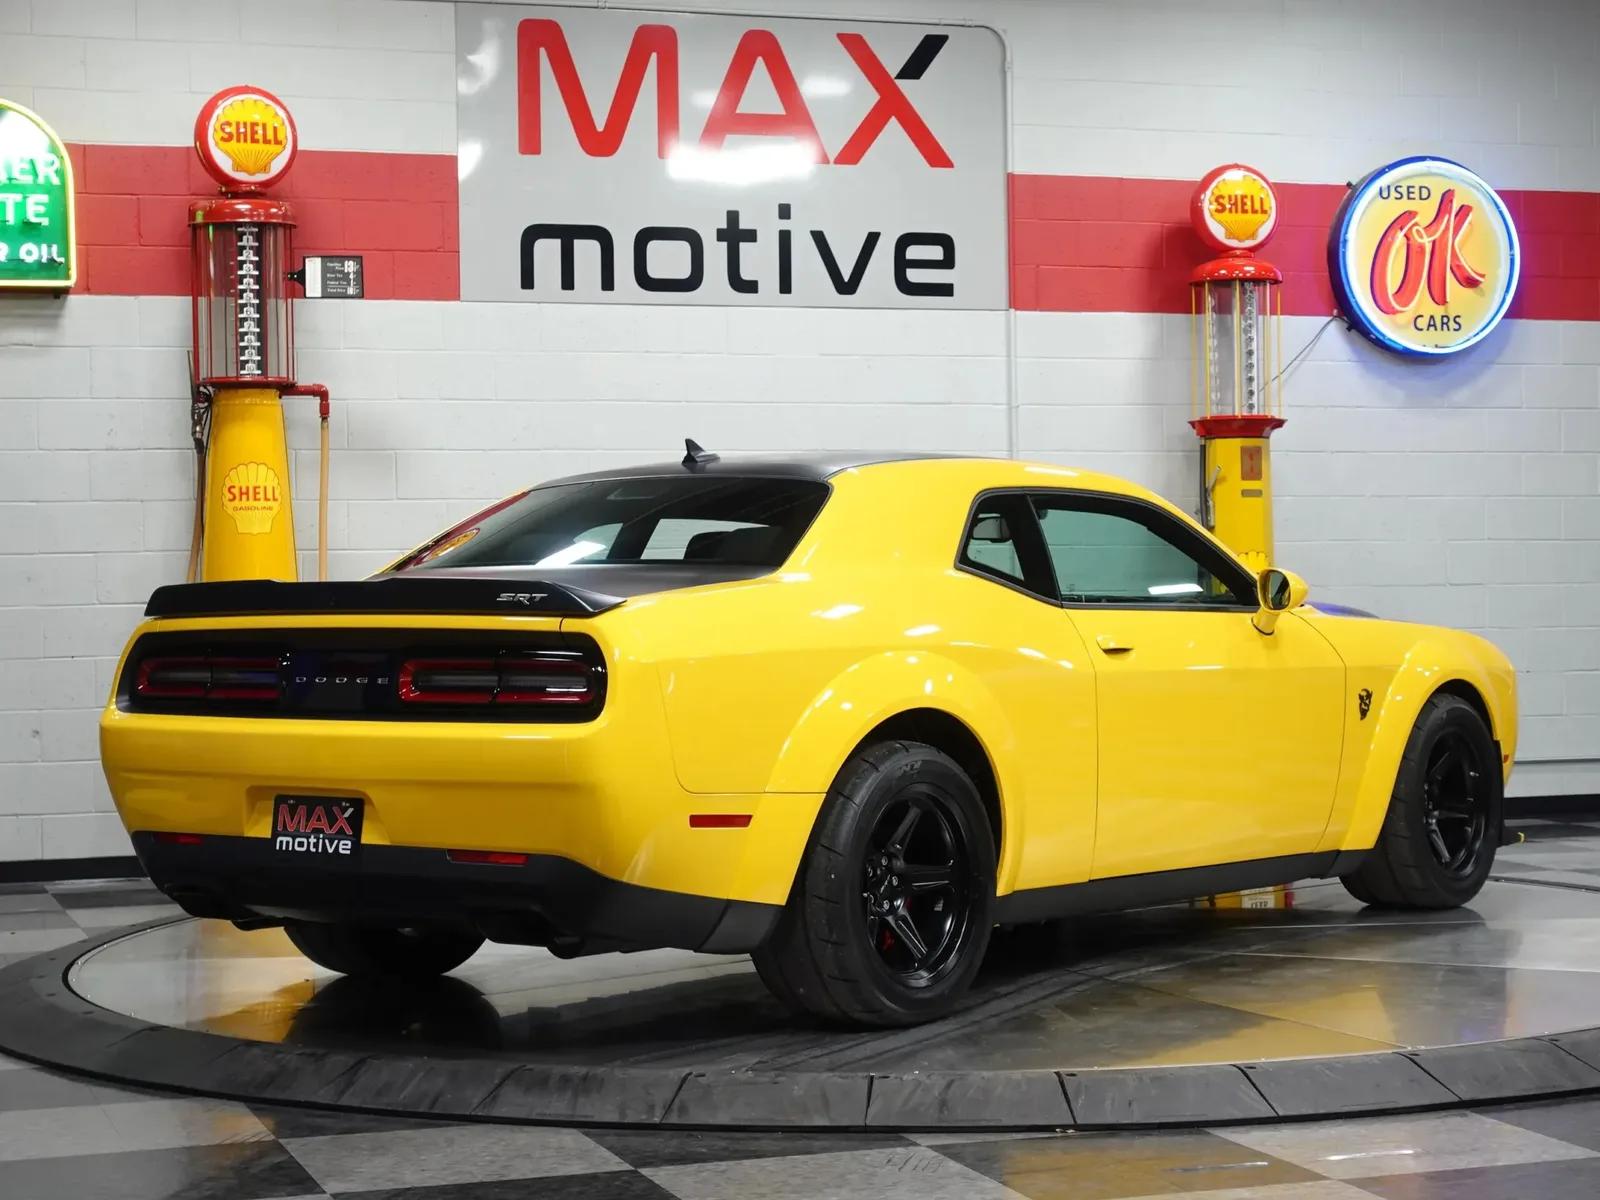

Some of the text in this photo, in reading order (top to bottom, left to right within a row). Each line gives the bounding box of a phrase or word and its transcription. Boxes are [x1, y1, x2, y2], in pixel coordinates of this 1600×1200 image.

[517, 18, 954, 168] MAX
[219, 120, 283, 146] SHELL
[1378, 185, 1432, 200] USED
[1214, 194, 1269, 215] SHELL
[19, 242, 65, 264] OIL
[520, 203, 955, 297] motive
[1370, 189, 1486, 315] OK
[1413, 315, 1462, 331] CARS
[227, 485, 279, 502] SHELL
[496, 593, 548, 605] SRT
[295, 676, 389, 685] DODGE
[277, 804, 354, 835] MAX
[276, 834, 352, 854] motive
